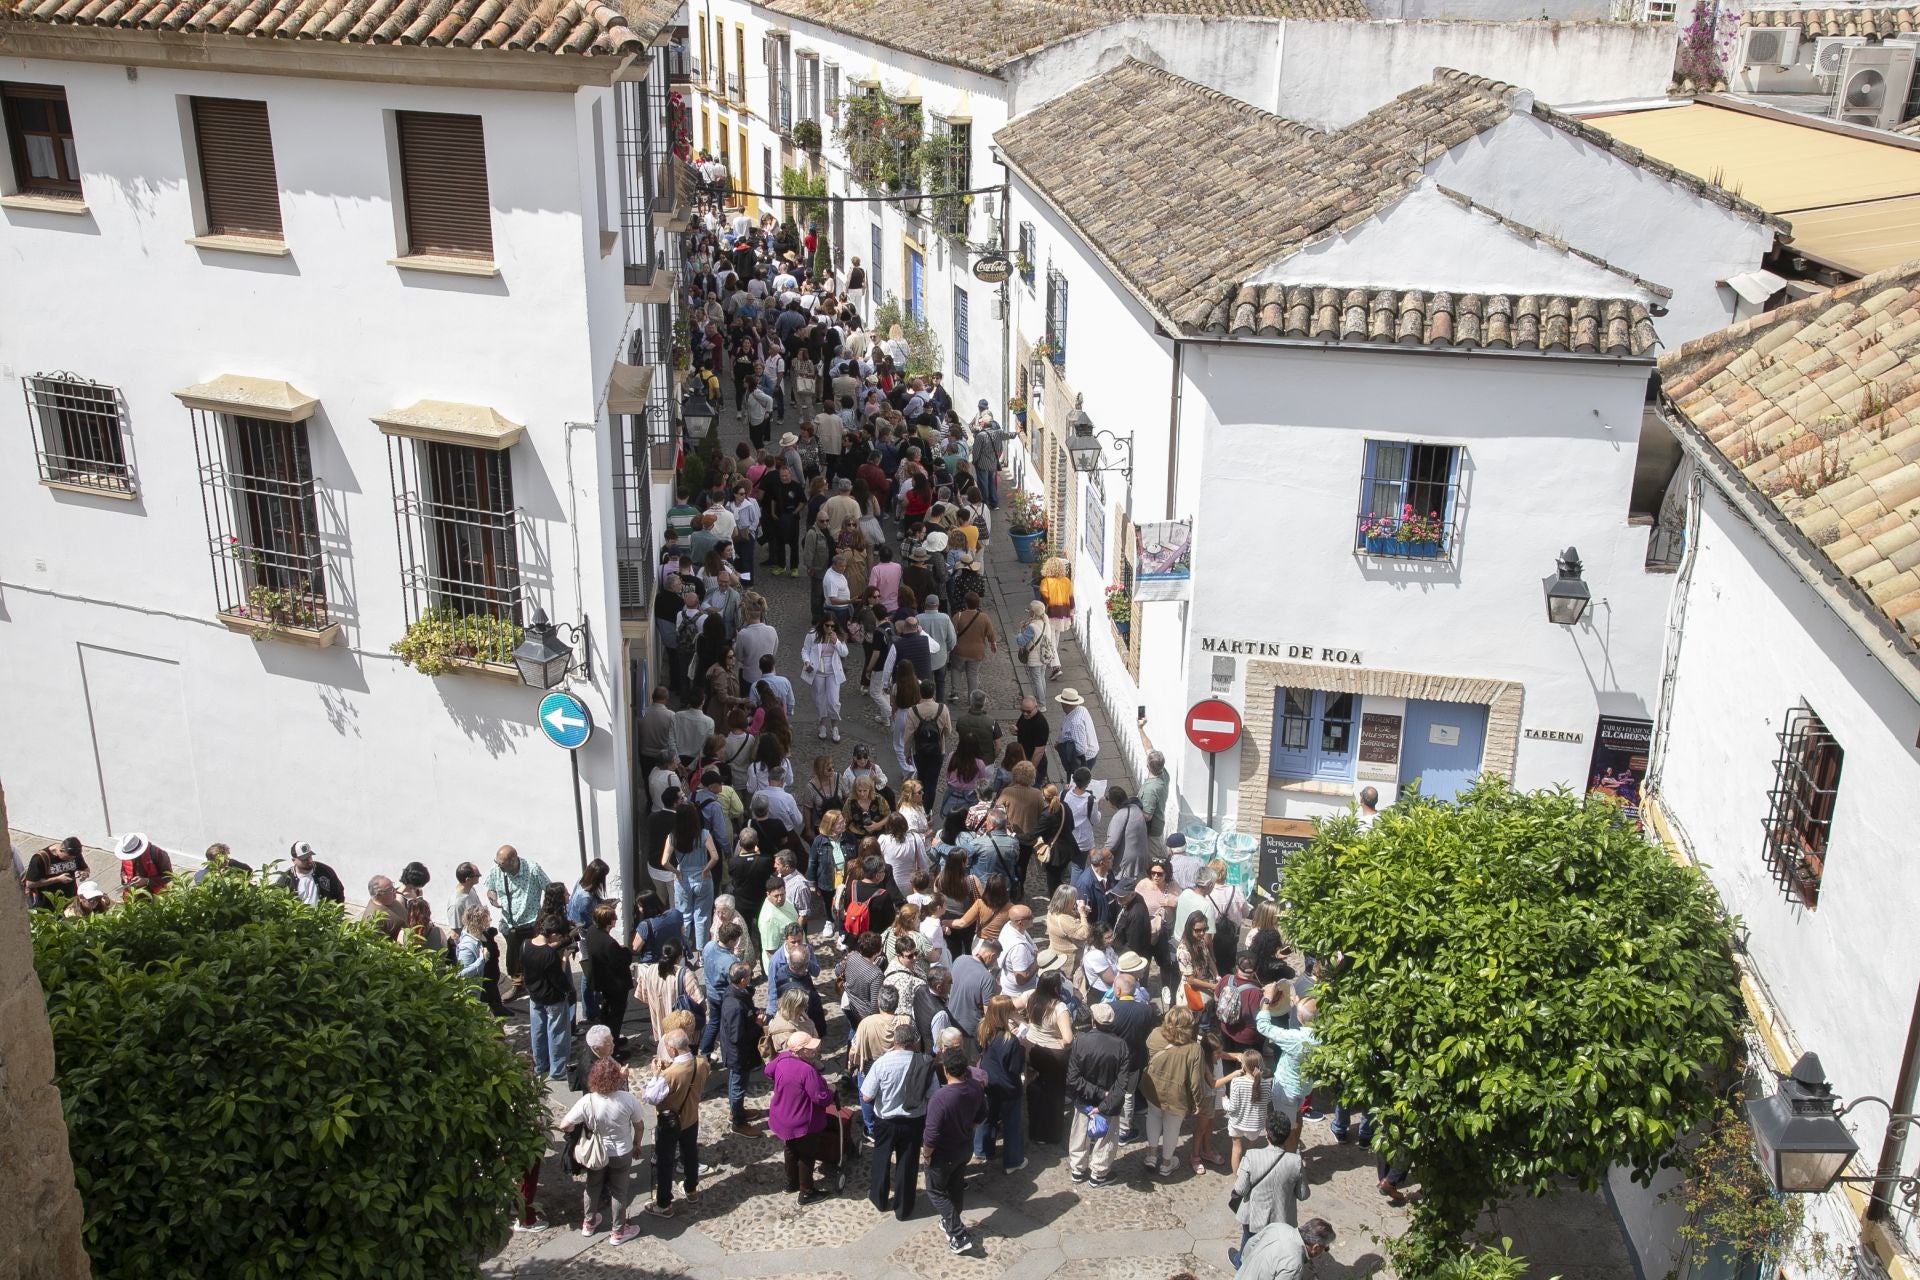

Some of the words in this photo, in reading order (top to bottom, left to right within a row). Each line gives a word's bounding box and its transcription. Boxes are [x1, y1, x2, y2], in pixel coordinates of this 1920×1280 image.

[1201, 637, 1280, 656] MARTIN
[1288, 645, 1313, 659] DE
[1321, 648, 1362, 664] ROA
[1525, 729, 1581, 741] TABERNA
[1601, 730, 1613, 738] EL
[1613, 731, 1651, 741] CARDENA
[1625, 726, 1651, 735] FLAMENC
